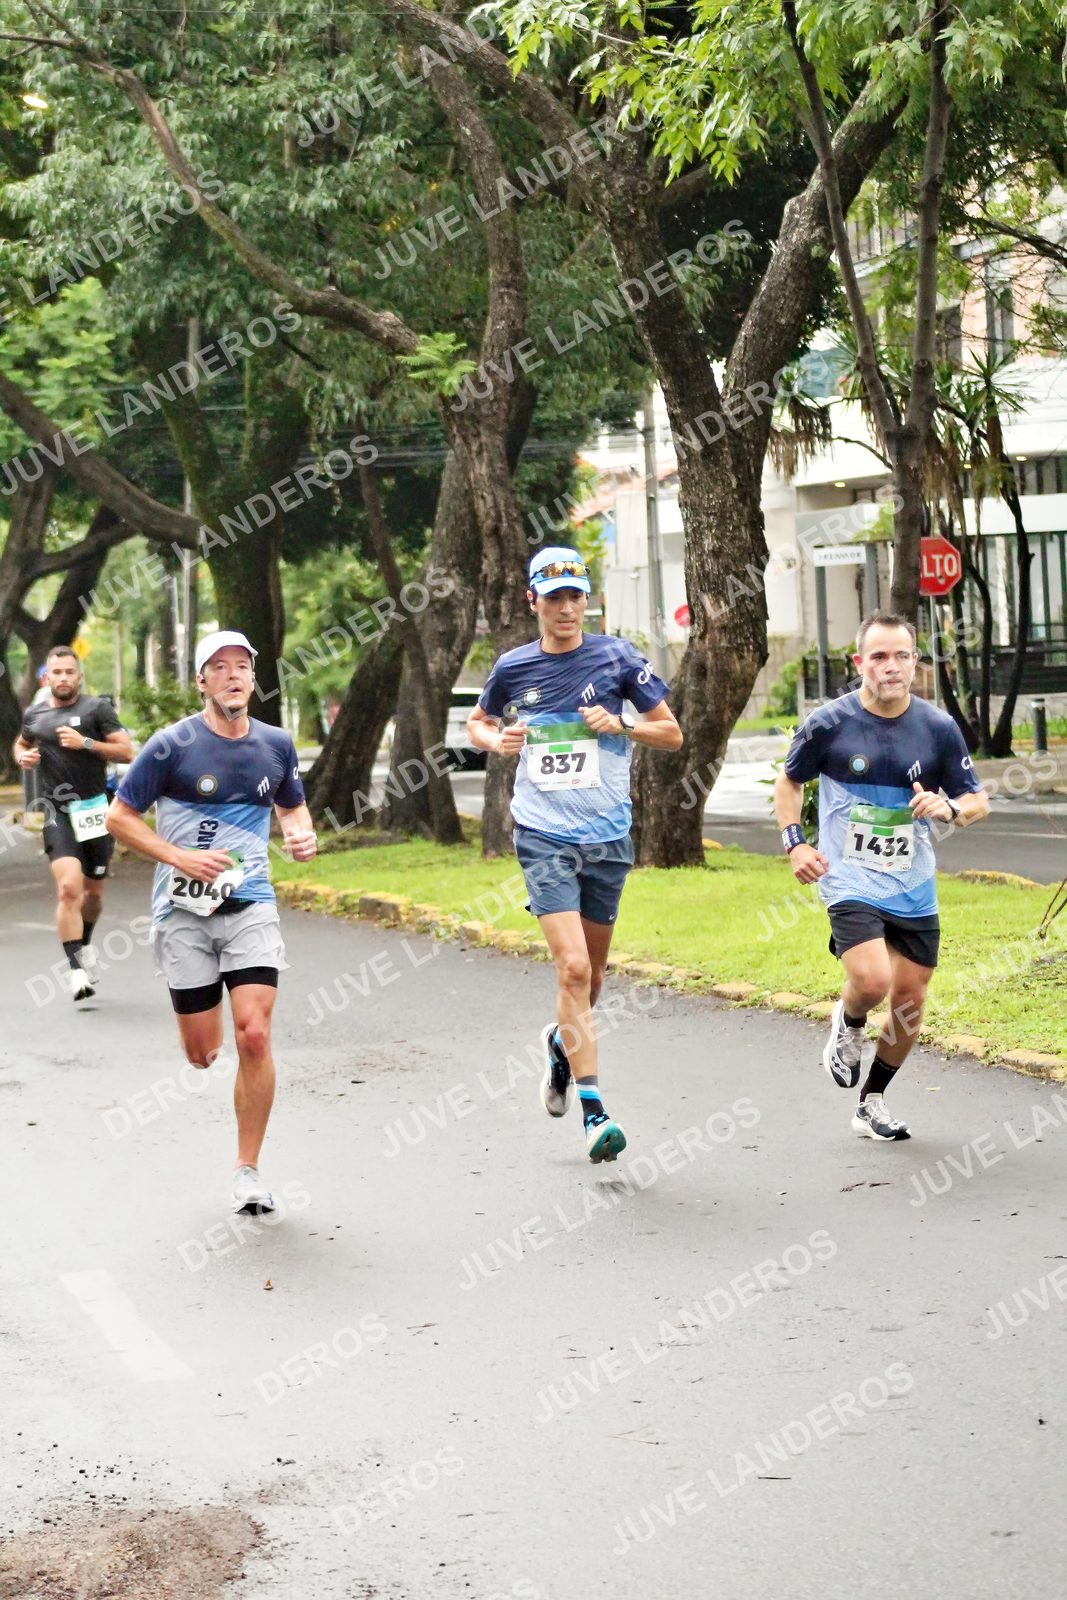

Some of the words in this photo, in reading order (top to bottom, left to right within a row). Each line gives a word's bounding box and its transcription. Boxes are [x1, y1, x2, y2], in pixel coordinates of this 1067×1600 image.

[922, 554, 958, 578] LTO
[540, 752, 587, 775] 837
[78, 813, 106, 829] 495
[853, 833, 909, 857] 1432
[172, 876, 235, 901] 2040
